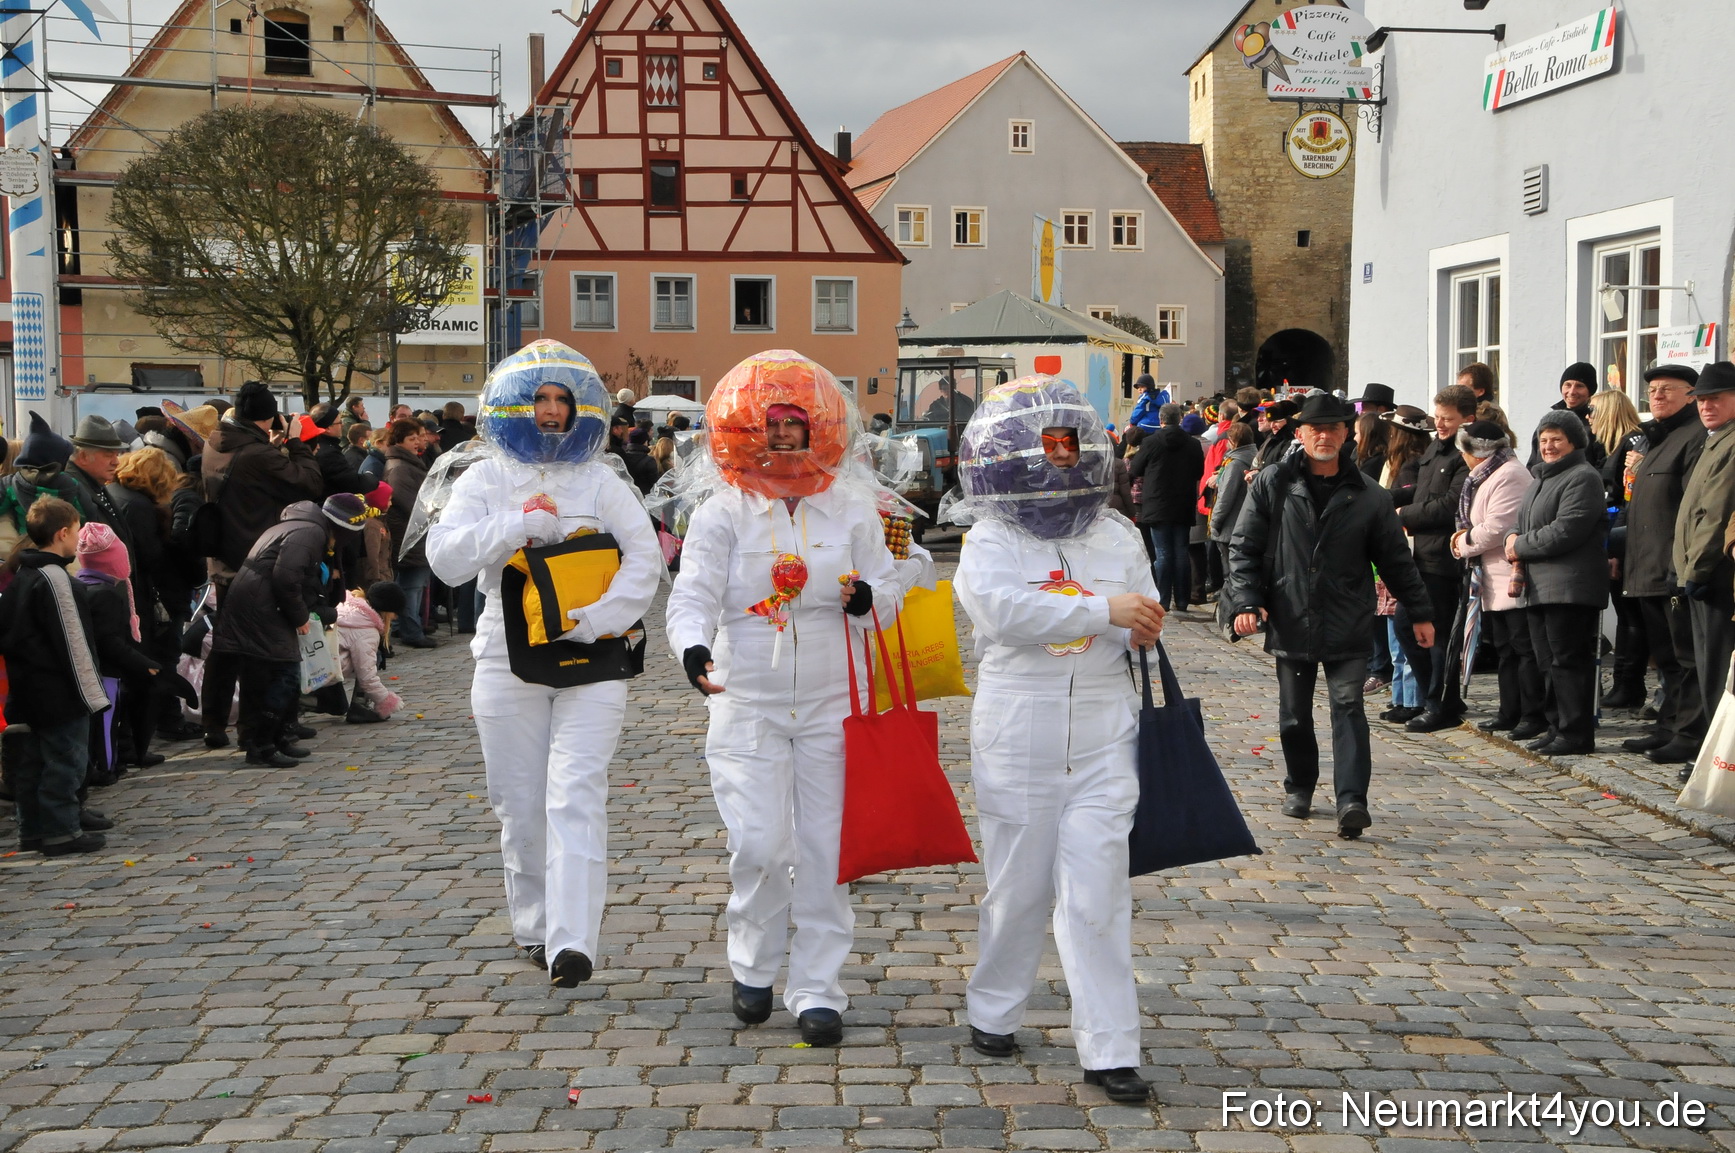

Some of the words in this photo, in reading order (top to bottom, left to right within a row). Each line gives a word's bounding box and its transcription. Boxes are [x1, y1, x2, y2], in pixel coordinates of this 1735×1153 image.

[1294, 9, 1350, 24] Pizzeria
[1307, 29, 1337, 43] Café
[1508, 44, 1534, 62] Pizzeria
[1561, 23, 1589, 43] Eisdiele
[1291, 45, 1350, 62] Eisdiele
[1301, 76, 1341, 85] Bella
[1503, 63, 1540, 97] Bella
[1543, 53, 1588, 84] Roma
[1273, 84, 1318, 93] Roma
[1661, 340, 1681, 349] Bella
[1667, 349, 1689, 359] Roma
[893, 650, 920, 659] MRIA
